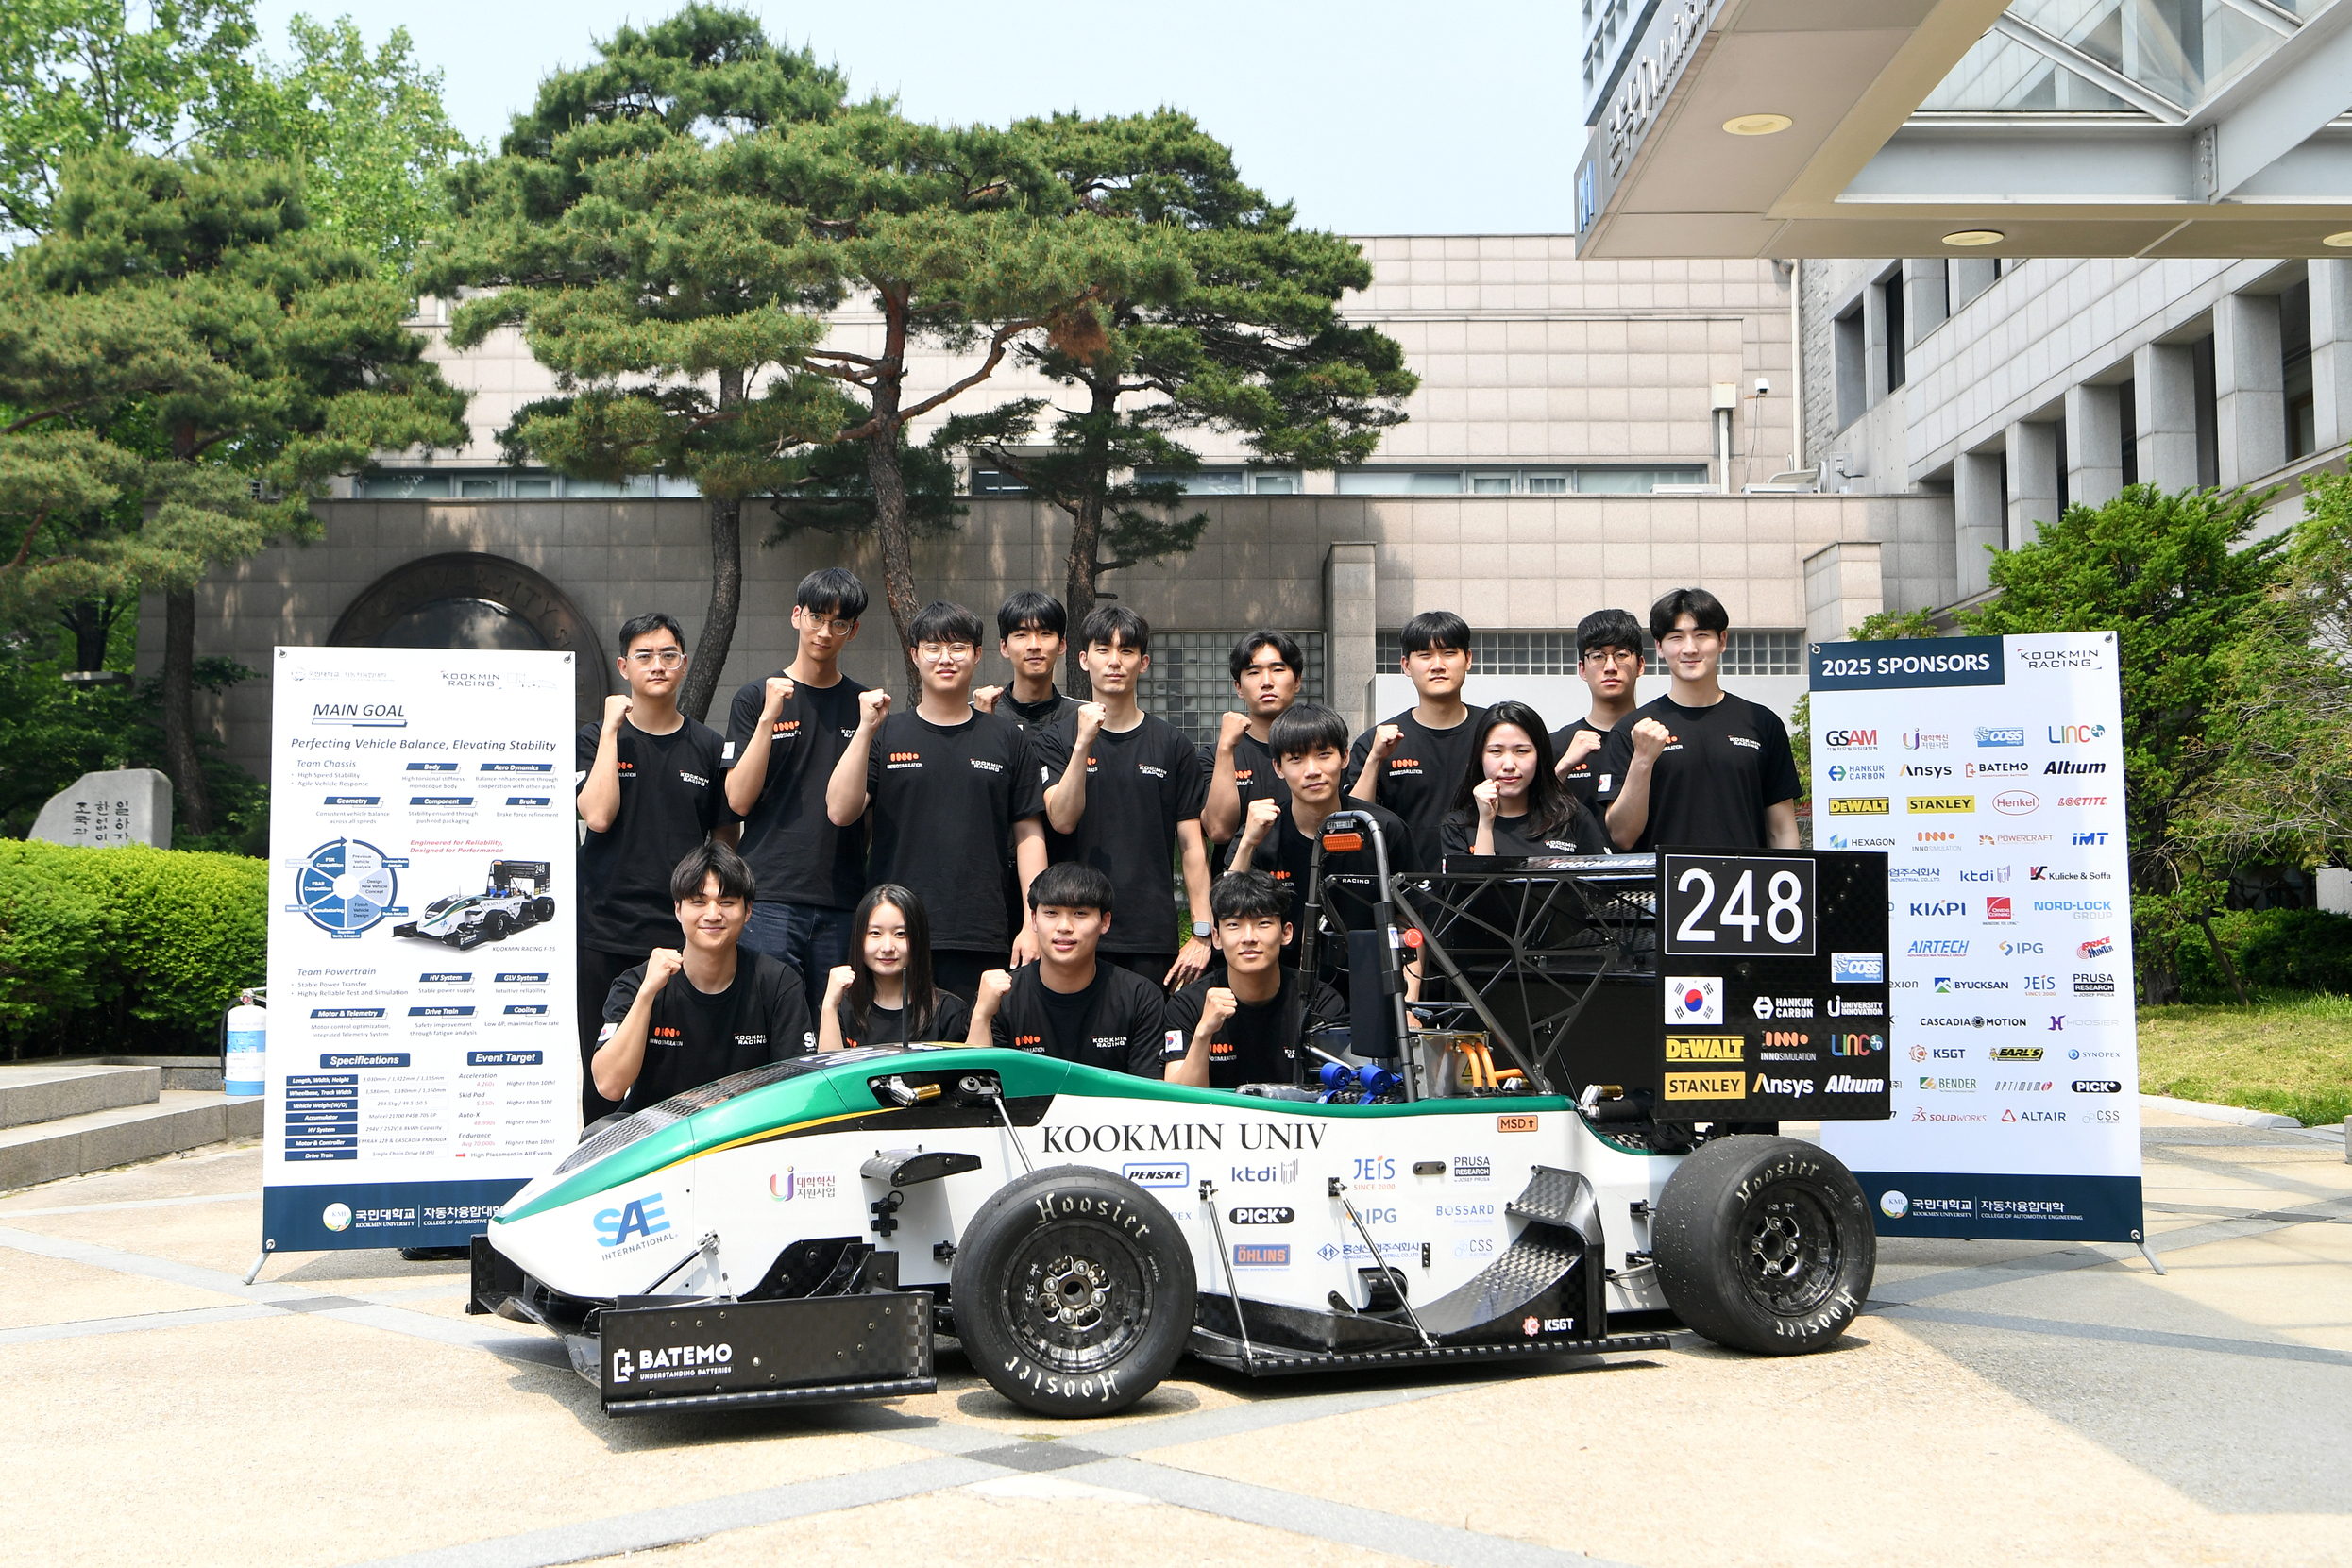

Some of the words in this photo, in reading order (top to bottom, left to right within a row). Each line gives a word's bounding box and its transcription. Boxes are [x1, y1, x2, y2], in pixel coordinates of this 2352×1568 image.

[2021, 649, 2098, 660] KOOKMIN
[1822, 659, 1871, 677] 2025
[1877, 654, 1990, 674] SPONSORS
[2029, 659, 2091, 668] RACING
[313, 704, 358, 716] MAIN
[364, 704, 404, 717] GOAL
[1826, 730, 1877, 746] GSAM
[1990, 731, 2023, 742] COSS
[291, 738, 350, 750] Perfecting
[356, 739, 396, 749] Vehicle
[399, 740, 448, 750] Balance,
[453, 740, 506, 751] Elevating
[510, 741, 557, 751] Stability
[971, 760, 1003, 769] KOOKMIN
[1979, 763, 2029, 772] BATEMO
[2043, 761, 2106, 775] Altium
[1900, 764, 1952, 779] Ansys
[1910, 800, 1971, 809] STANLEY
[1997, 798, 2035, 807] Henkel
[2058, 797, 2107, 806] LOCTITE
[113, 801, 130, 840] 일하자
[1960, 870, 1993, 882] ktdi
[1676, 868, 1804, 944] 248
[2034, 902, 2112, 911] NORD-LOCK
[1907, 940, 1970, 953] AIRTECH
[2017, 943, 2043, 954] IPG
[2082, 936, 2110, 951] PRICE
[1848, 960, 1881, 974] COSS
[1775, 998, 1814, 1007] HANKUK
[1775, 1007, 1814, 1019] CARBON
[1092, 1036, 1127, 1044] KOOKMIN
[475, 1054, 503, 1062] Event
[506, 1054, 535, 1063] Target
[1761, 1053, 1817, 1061] INNOSIMULATION
[1933, 1049, 1966, 1058] KSGT
[2000, 1048, 2039, 1056] EARL'S
[330, 1056, 399, 1067] Specifications
[1669, 1079, 1740, 1092] STANLEY
[1752, 1073, 1814, 1098] Ansys
[1824, 1075, 1884, 1093] Altium
[1939, 1078, 1977, 1088] BENDER
[2021, 1112, 2066, 1121] ALTAIR
[2097, 1110, 2120, 1121] CSS
[1500, 1119, 1526, 1129] MSD
[1042, 1123, 1225, 1153] KOOKMIN
[1238, 1123, 1328, 1150] UNIV
[1454, 1156, 1490, 1167] PRUSA
[1128, 1170, 1184, 1181] PENSKE
[1231, 1166, 1277, 1182] ktdi
[1455, 1168, 1489, 1176] RESEARCH
[796, 1175, 836, 1188] 대학혁신
[1736, 1154, 1819, 1209] Hoosier
[797, 1187, 836, 1199] 지원사업
[1436, 1204, 1494, 1216] BOSSARD
[1912, 1199, 1972, 1210] 국민대학교
[1981, 1200, 2065, 1213] 자동차융합대학
[355, 1208, 415, 1221] 국민대학교
[593, 1192, 671, 1247] SAE
[1035, 1192, 1151, 1239] Hoosier
[1366, 1208, 1396, 1224] IPG
[601, 1232, 675, 1261] INTERNATIONAL
[1469, 1239, 1493, 1253] CSS
[1238, 1246, 1286, 1263] ÖHLINS
[1776, 1286, 1859, 1344] Hoosier
[1544, 1318, 1574, 1331] KSGT
[639, 1343, 733, 1370] BATEMO
[640, 1370, 695, 1380] UNDERSTANDING
[697, 1366, 733, 1377] BATTERIES
[1005, 1356, 1120, 1402] Hoosier
